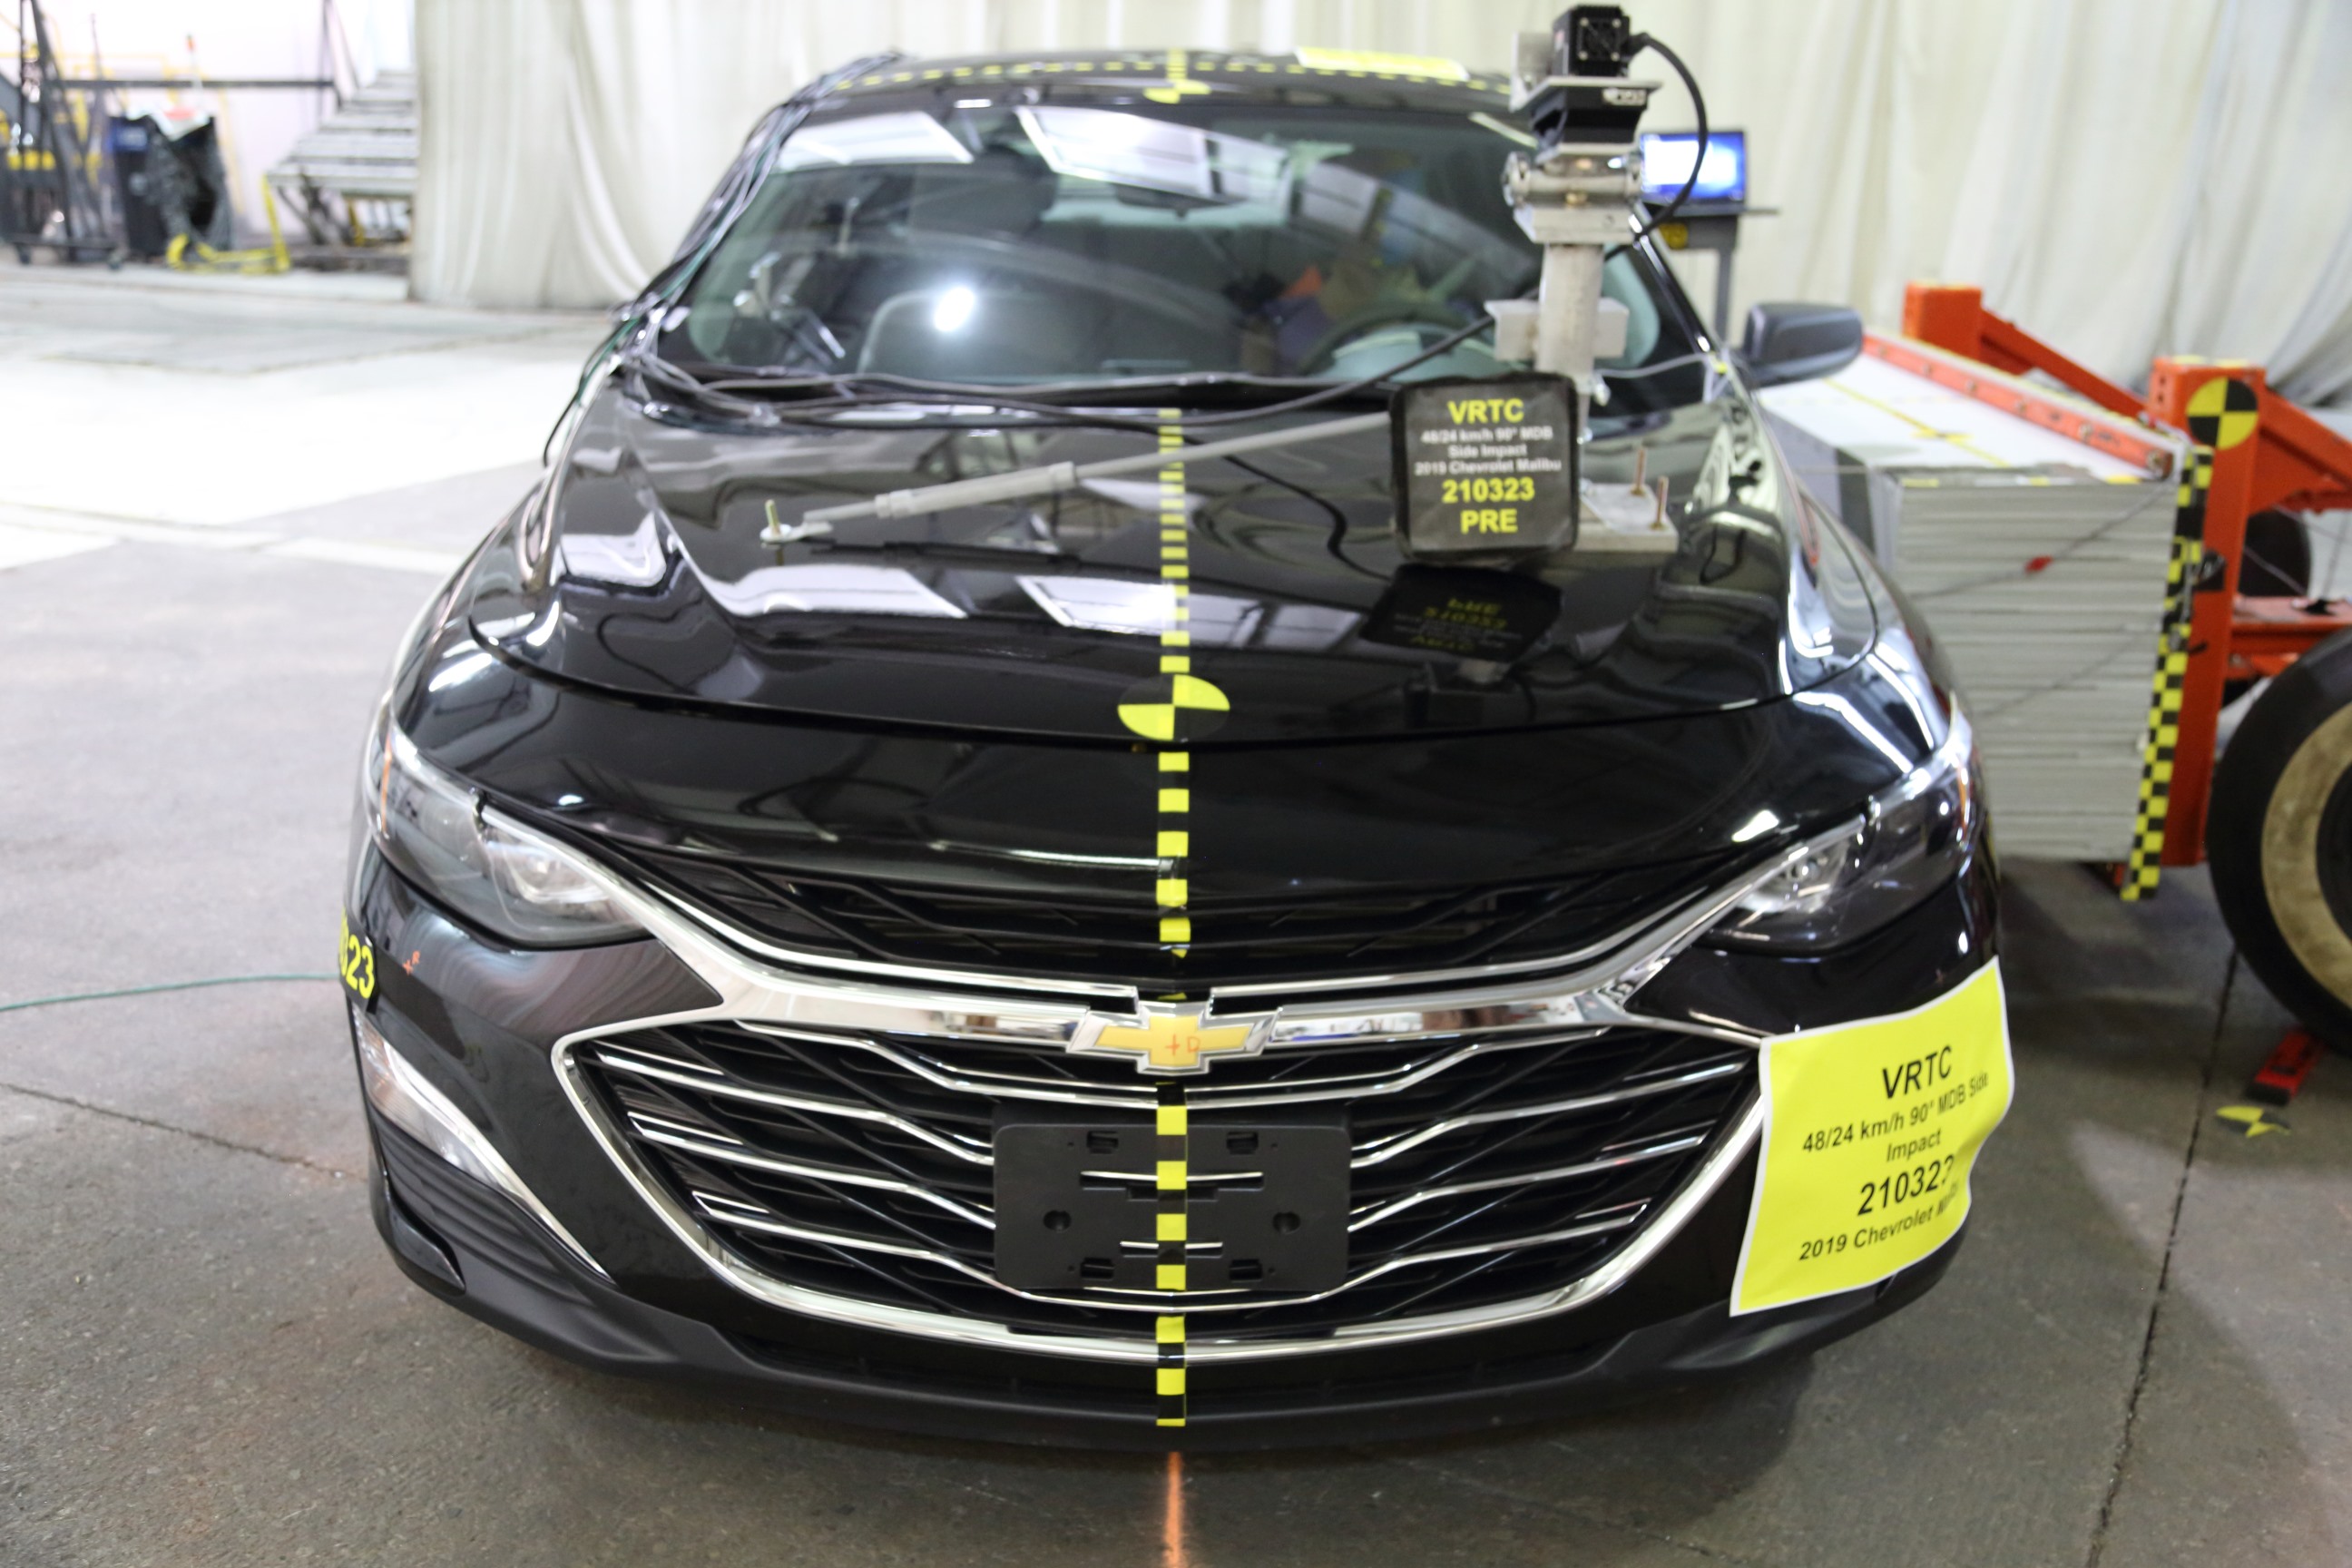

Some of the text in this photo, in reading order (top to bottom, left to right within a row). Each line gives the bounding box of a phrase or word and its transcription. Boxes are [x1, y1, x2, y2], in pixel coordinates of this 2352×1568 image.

[1447, 397, 1524, 424] VRTC
[1520, 426, 1553, 440] MDB
[1448, 444, 1527, 459] Side Impact
[1415, 457, 1562, 475] 2019 Chevrolet Malibu
[1442, 476, 1535, 504] 210323
[1461, 508, 1518, 534] PRE
[1882, 1045, 1952, 1100] VRTC
[1802, 1123, 1853, 1152] 48/24
[1860, 1112, 1905, 1140] km/h
[1938, 1083, 1966, 1115] MDB
[1886, 1128, 1941, 1162] Impact
[1799, 1205, 1934, 1260] 2019 Chevrolet
